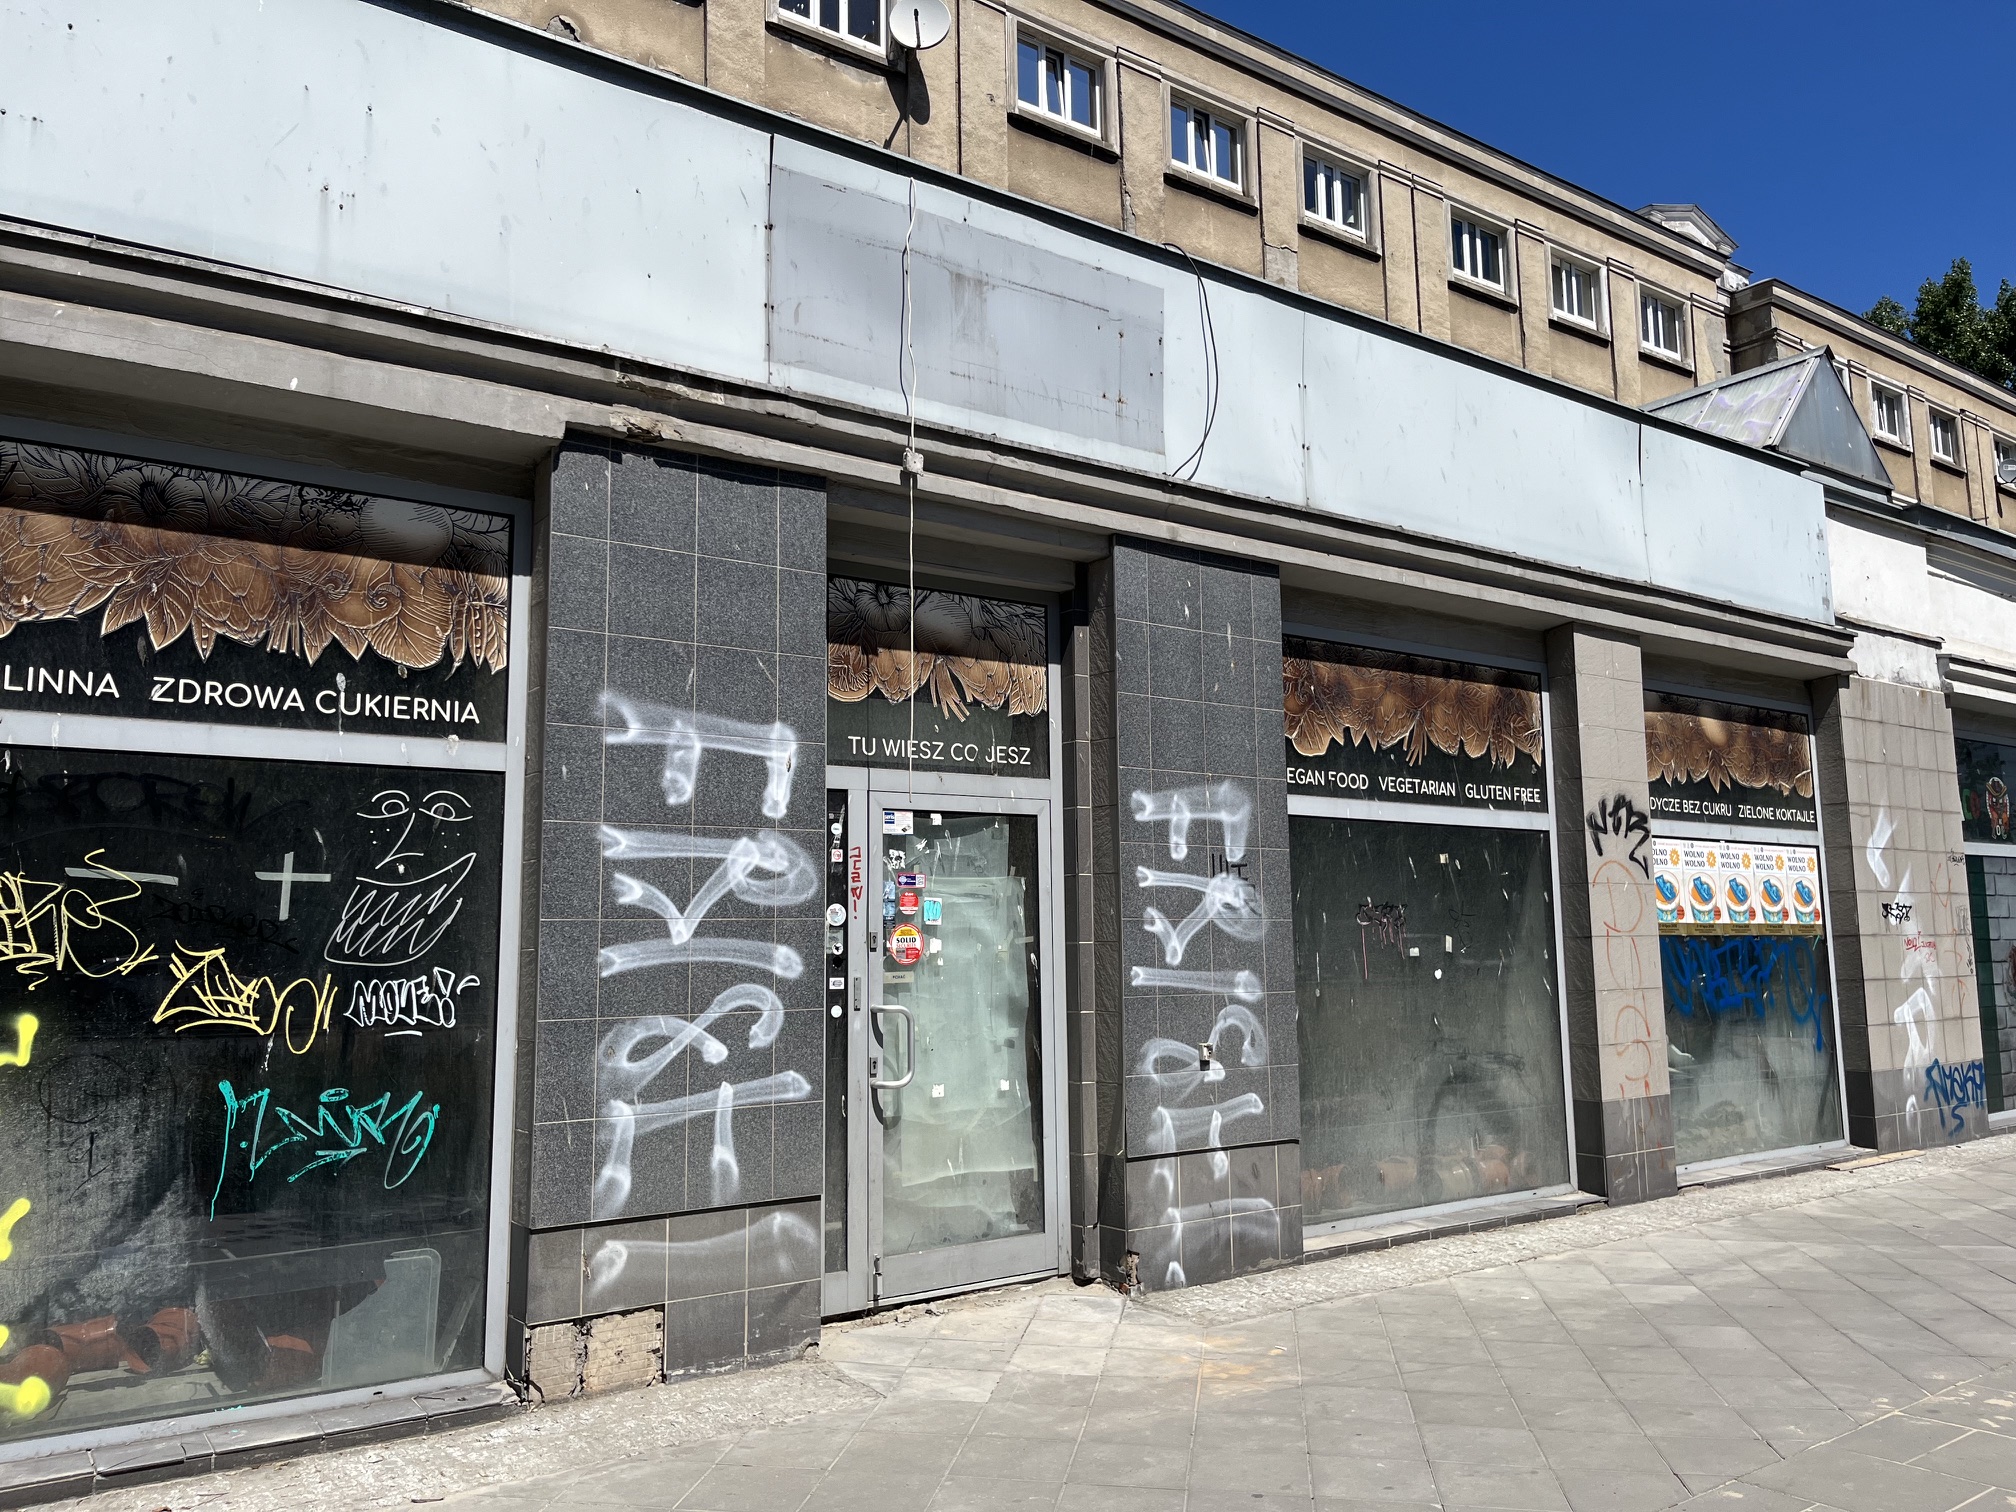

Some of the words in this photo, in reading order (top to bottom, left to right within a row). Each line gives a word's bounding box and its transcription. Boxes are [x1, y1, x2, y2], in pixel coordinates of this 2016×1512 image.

[3, 664, 120, 699] LINNA
[151, 676, 305, 712] ZDROWA
[315, 689, 480, 724] CUKIERNIA
[848, 735, 876, 756] TU
[882, 738, 945, 761] WIESZ
[950, 743, 979, 762] CO
[985, 744, 1032, 765] JESZ
[1286, 767, 1325, 786] EGAN
[1329, 771, 1369, 790] FOOD
[1378, 776, 1456, 797] VEGETARIAN
[1464, 783, 1512, 801] GLUTEN
[1513, 787, 1541, 804] FREE
[1649, 797, 1682, 813] DYCZE
[1682, 799, 1701, 814] BEZ
[1702, 802, 1732, 817] CUKRU
[1738, 804, 1775, 820] ZIELONE
[1776, 807, 1815, 823] KOKTAJLE
[1683, 850, 1705, 859] WOLNO
[1719, 852, 1740, 861] WOLNO
[1753, 854, 1774, 862] WOLNO
[1684, 859, 1706, 868] WOLNO
[1787, 856, 1806, 864] WOLNO
[1720, 861, 1741, 870] WOLNO
[1755, 862, 1775, 871] WOLNO
[1788, 864, 1807, 873] WOLNO
[896, 936, 917, 944] SOLID
